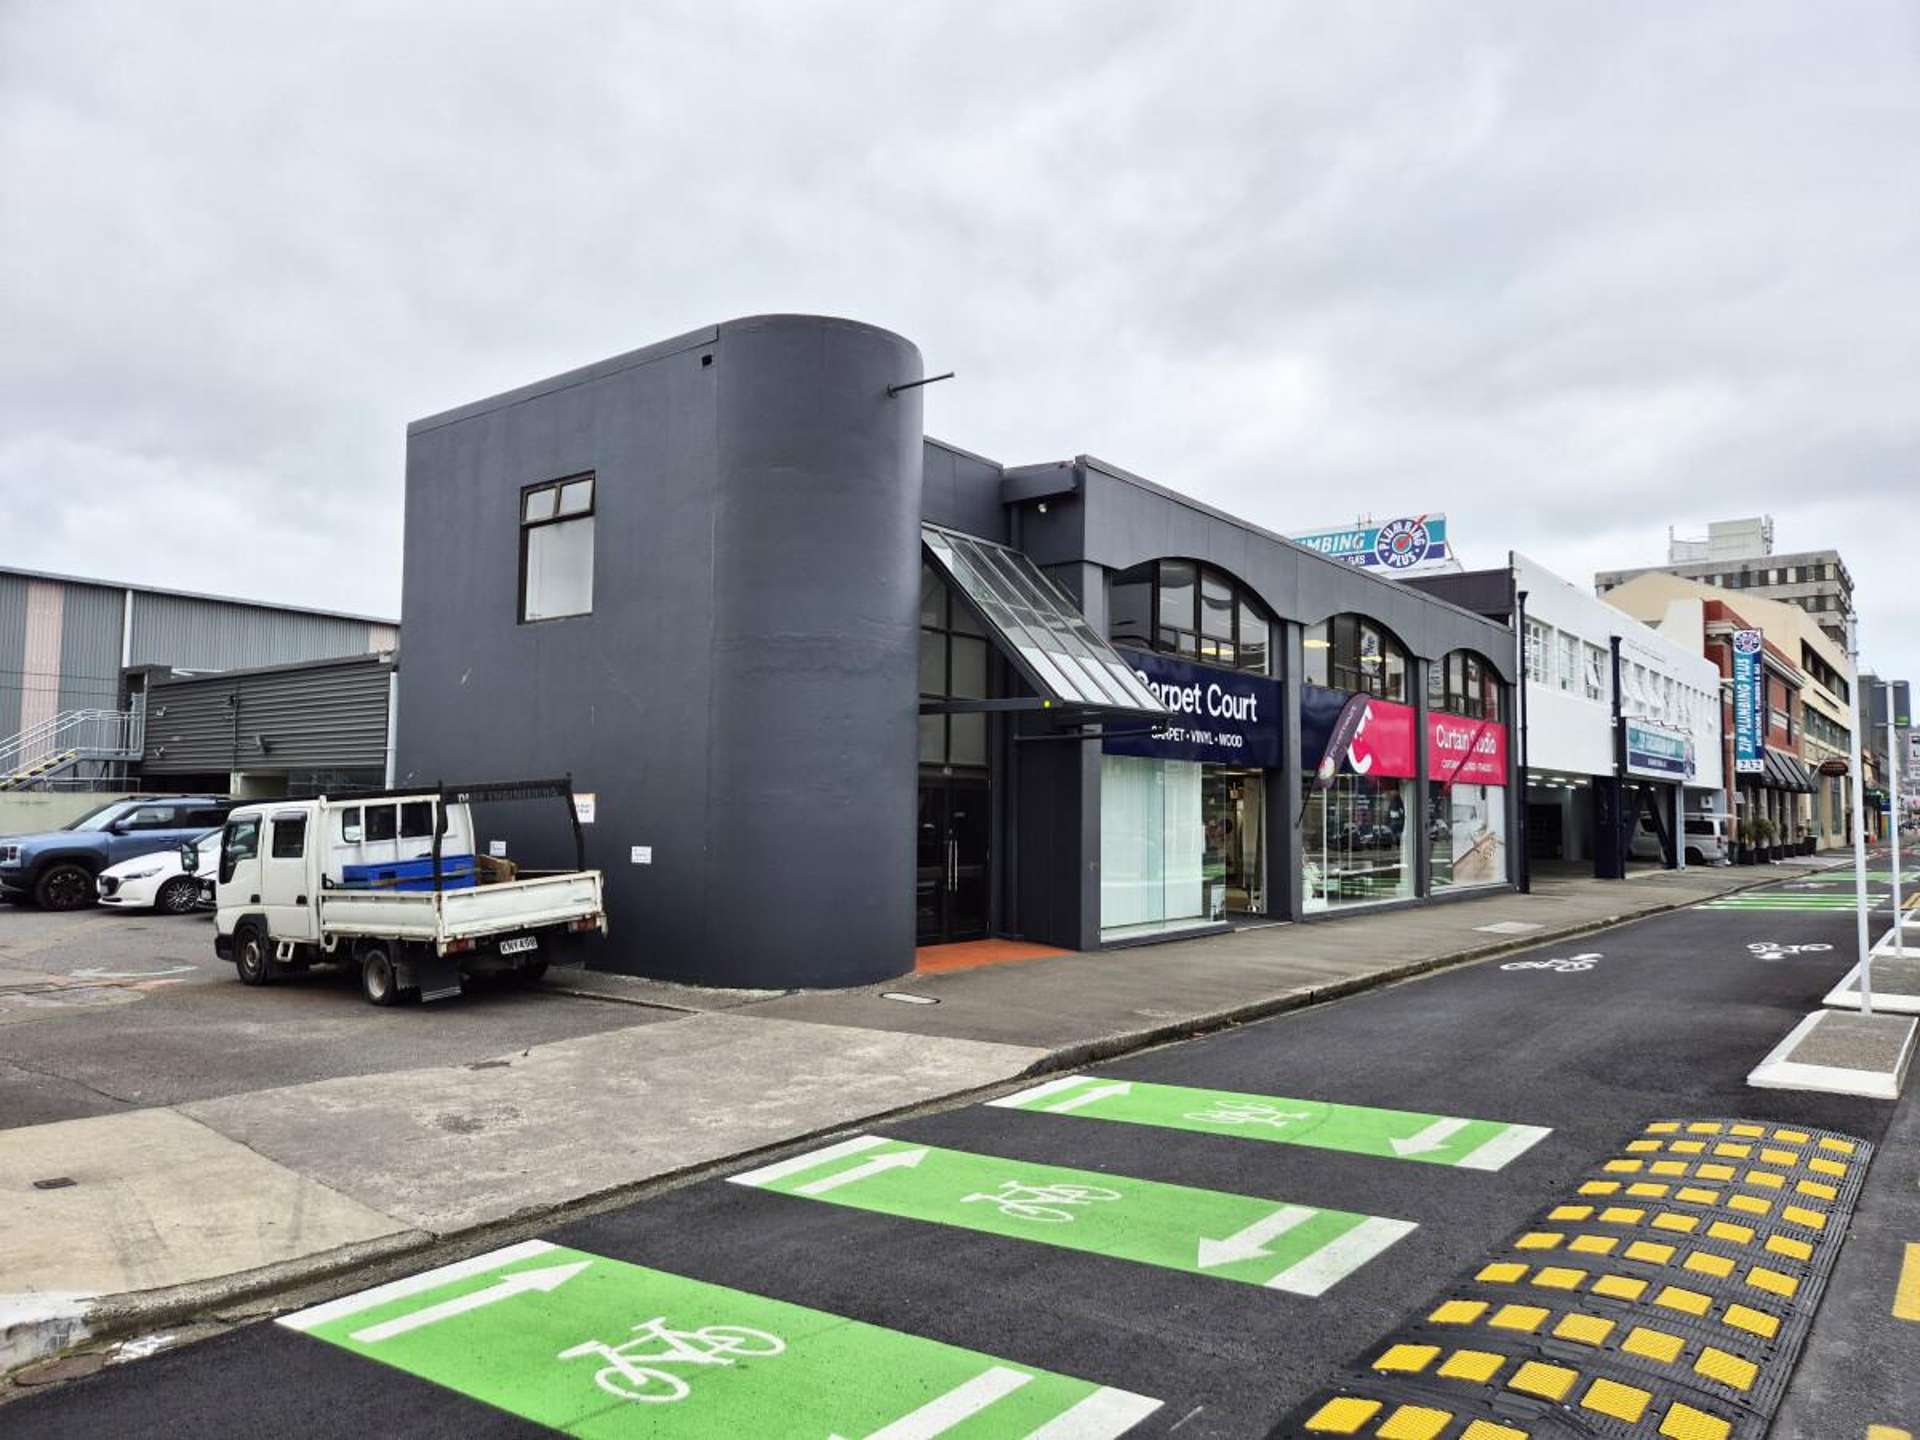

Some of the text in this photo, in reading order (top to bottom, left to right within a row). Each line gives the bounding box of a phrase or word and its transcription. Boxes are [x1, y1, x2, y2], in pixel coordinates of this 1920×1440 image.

[1378, 521, 1426, 550] PLUMBING
[1388, 551, 1417, 566] PLUS
[1736, 658, 1751, 681] PLUS
[1207, 683, 1258, 722] Court
[1737, 684, 1752, 735] PLUMBING
[1190, 729, 1214, 745] VINYL
[1219, 733, 1243, 748] WOOD
[1436, 724, 1497, 755] Curtain Sudio
